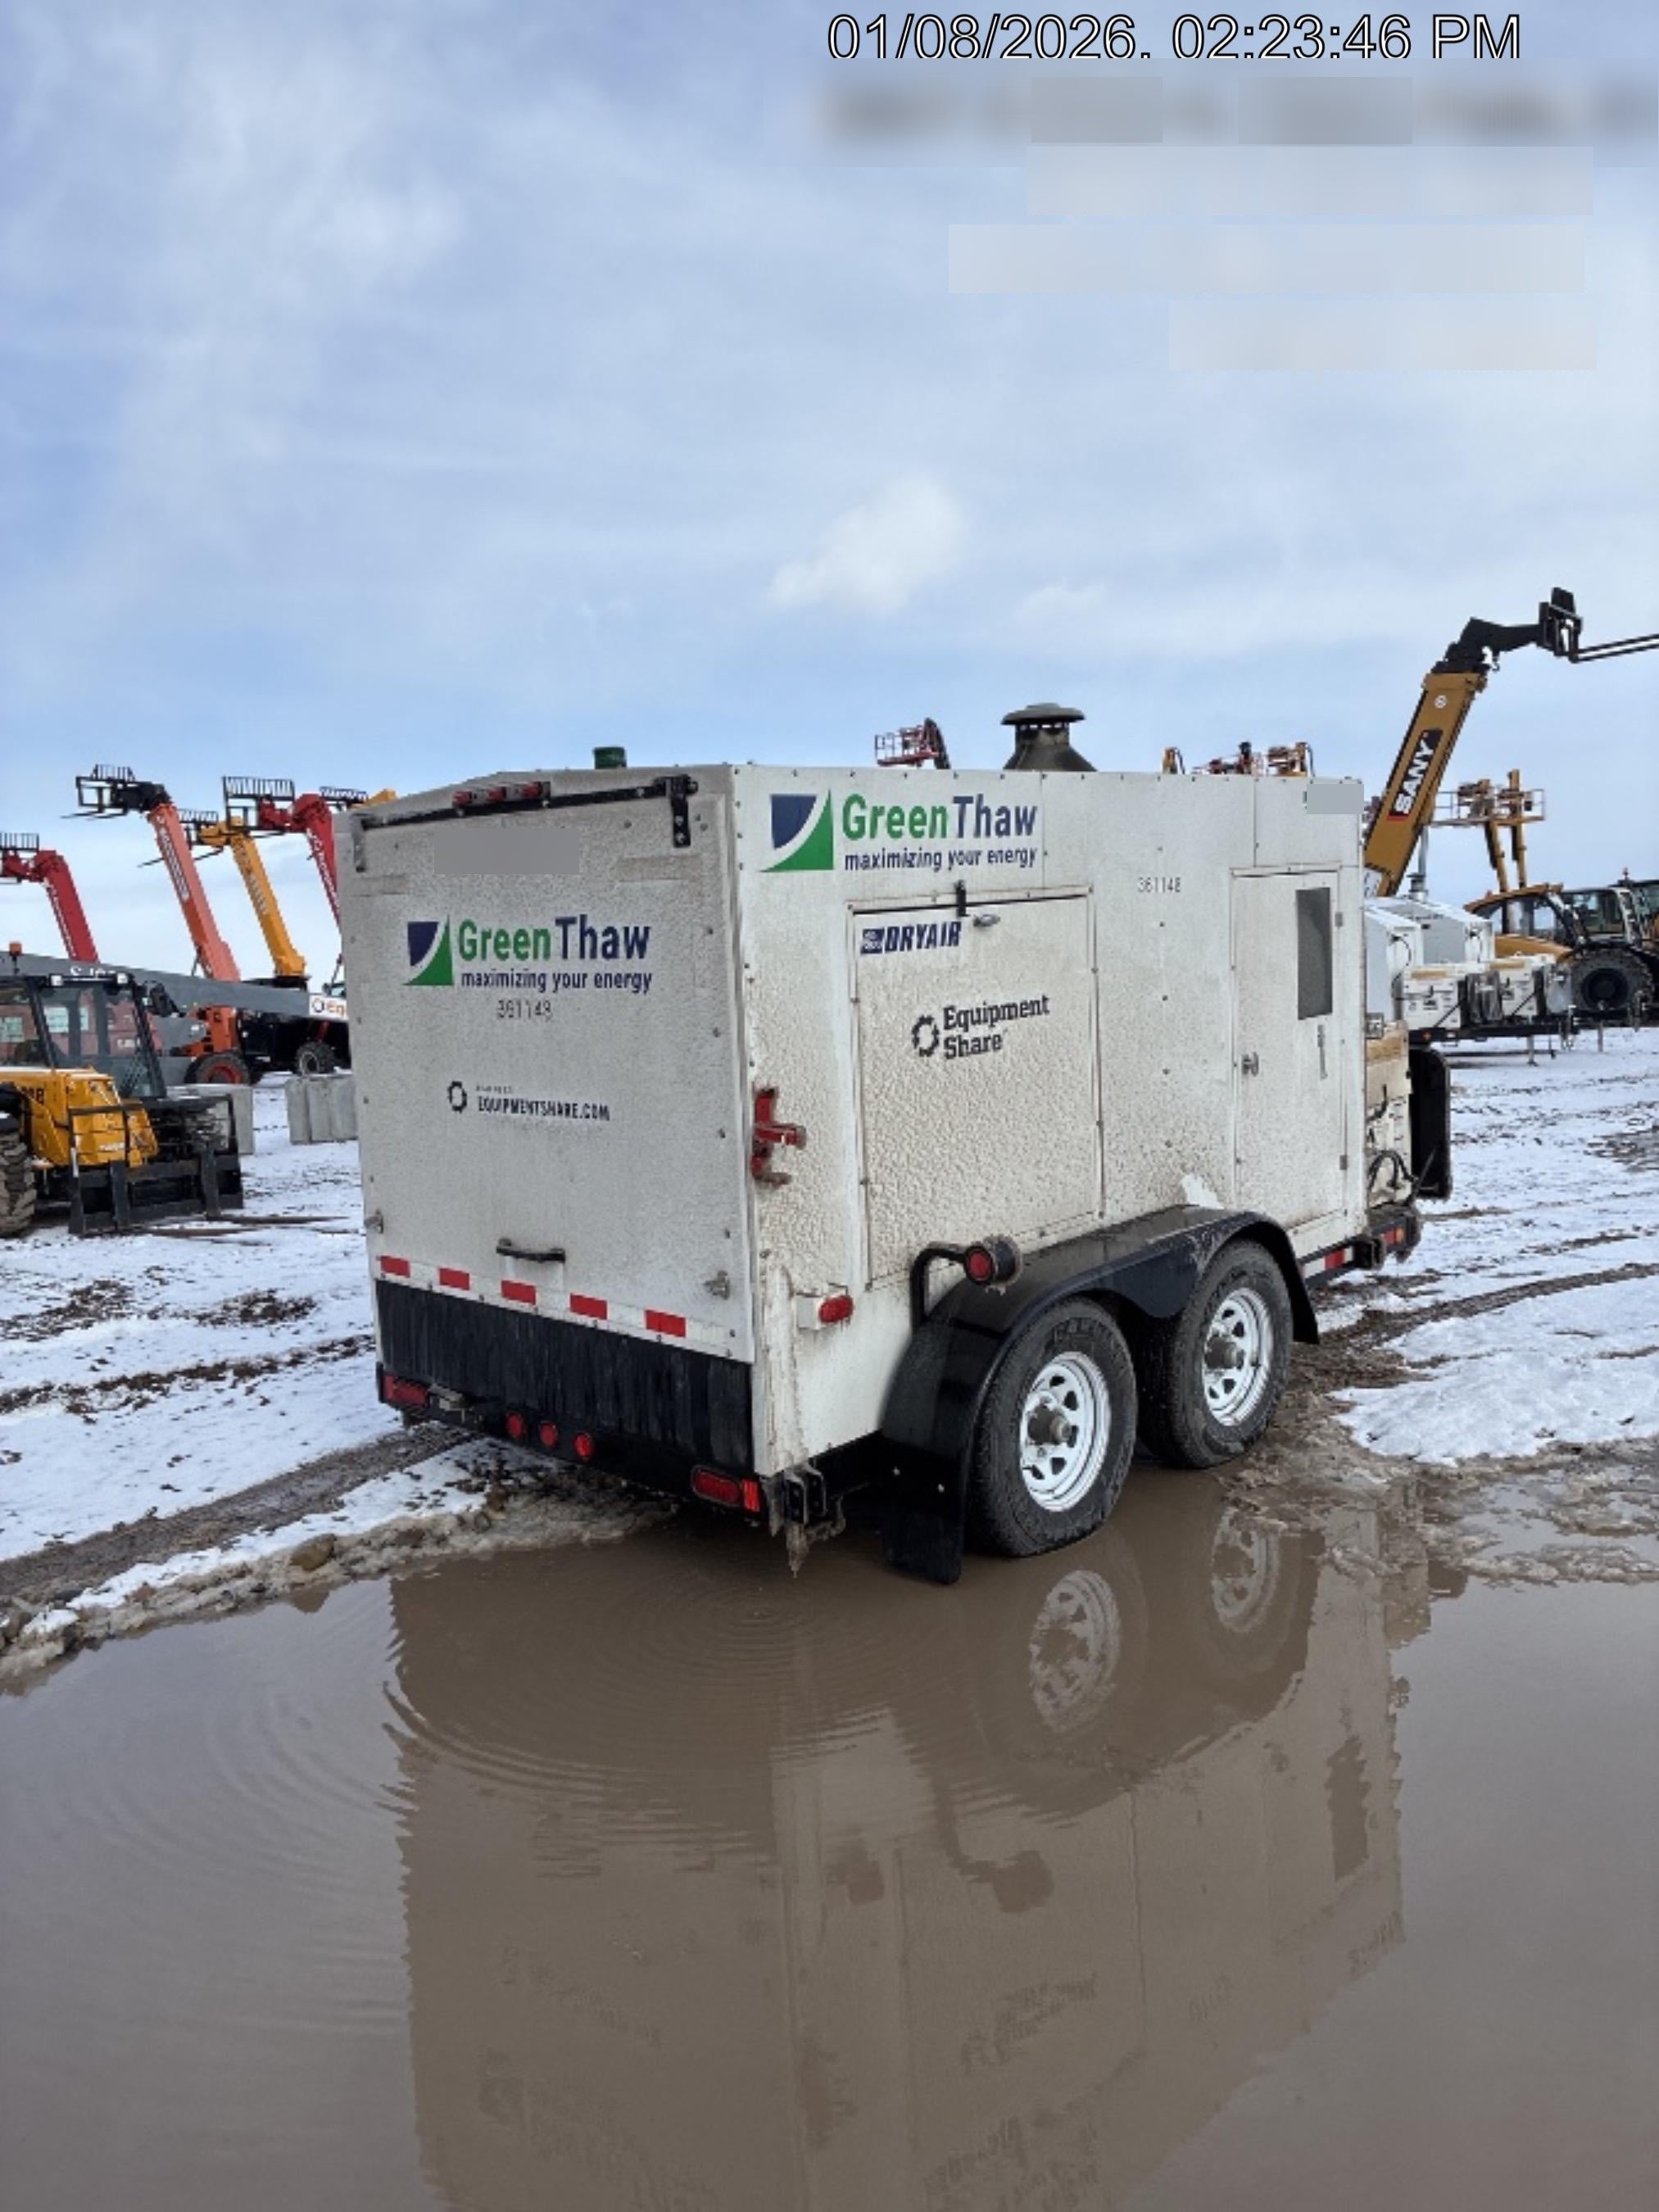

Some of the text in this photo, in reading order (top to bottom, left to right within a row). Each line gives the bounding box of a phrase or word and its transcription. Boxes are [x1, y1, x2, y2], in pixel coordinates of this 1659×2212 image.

[1394, 739, 1434, 814] SANY
[842, 793, 1038, 841] GreenThaw
[845, 846, 1038, 873] maximizing your energy
[458, 913, 652, 961] GreenThaw
[885, 920, 962, 954] DRYAIR
[461, 968, 653, 995] maximizing your energy
[943, 995, 1050, 1033] Equipment
[944, 1034, 1003, 1060] Share
[478, 1095, 610, 1122] EQUIPMENTSHARE.COM
